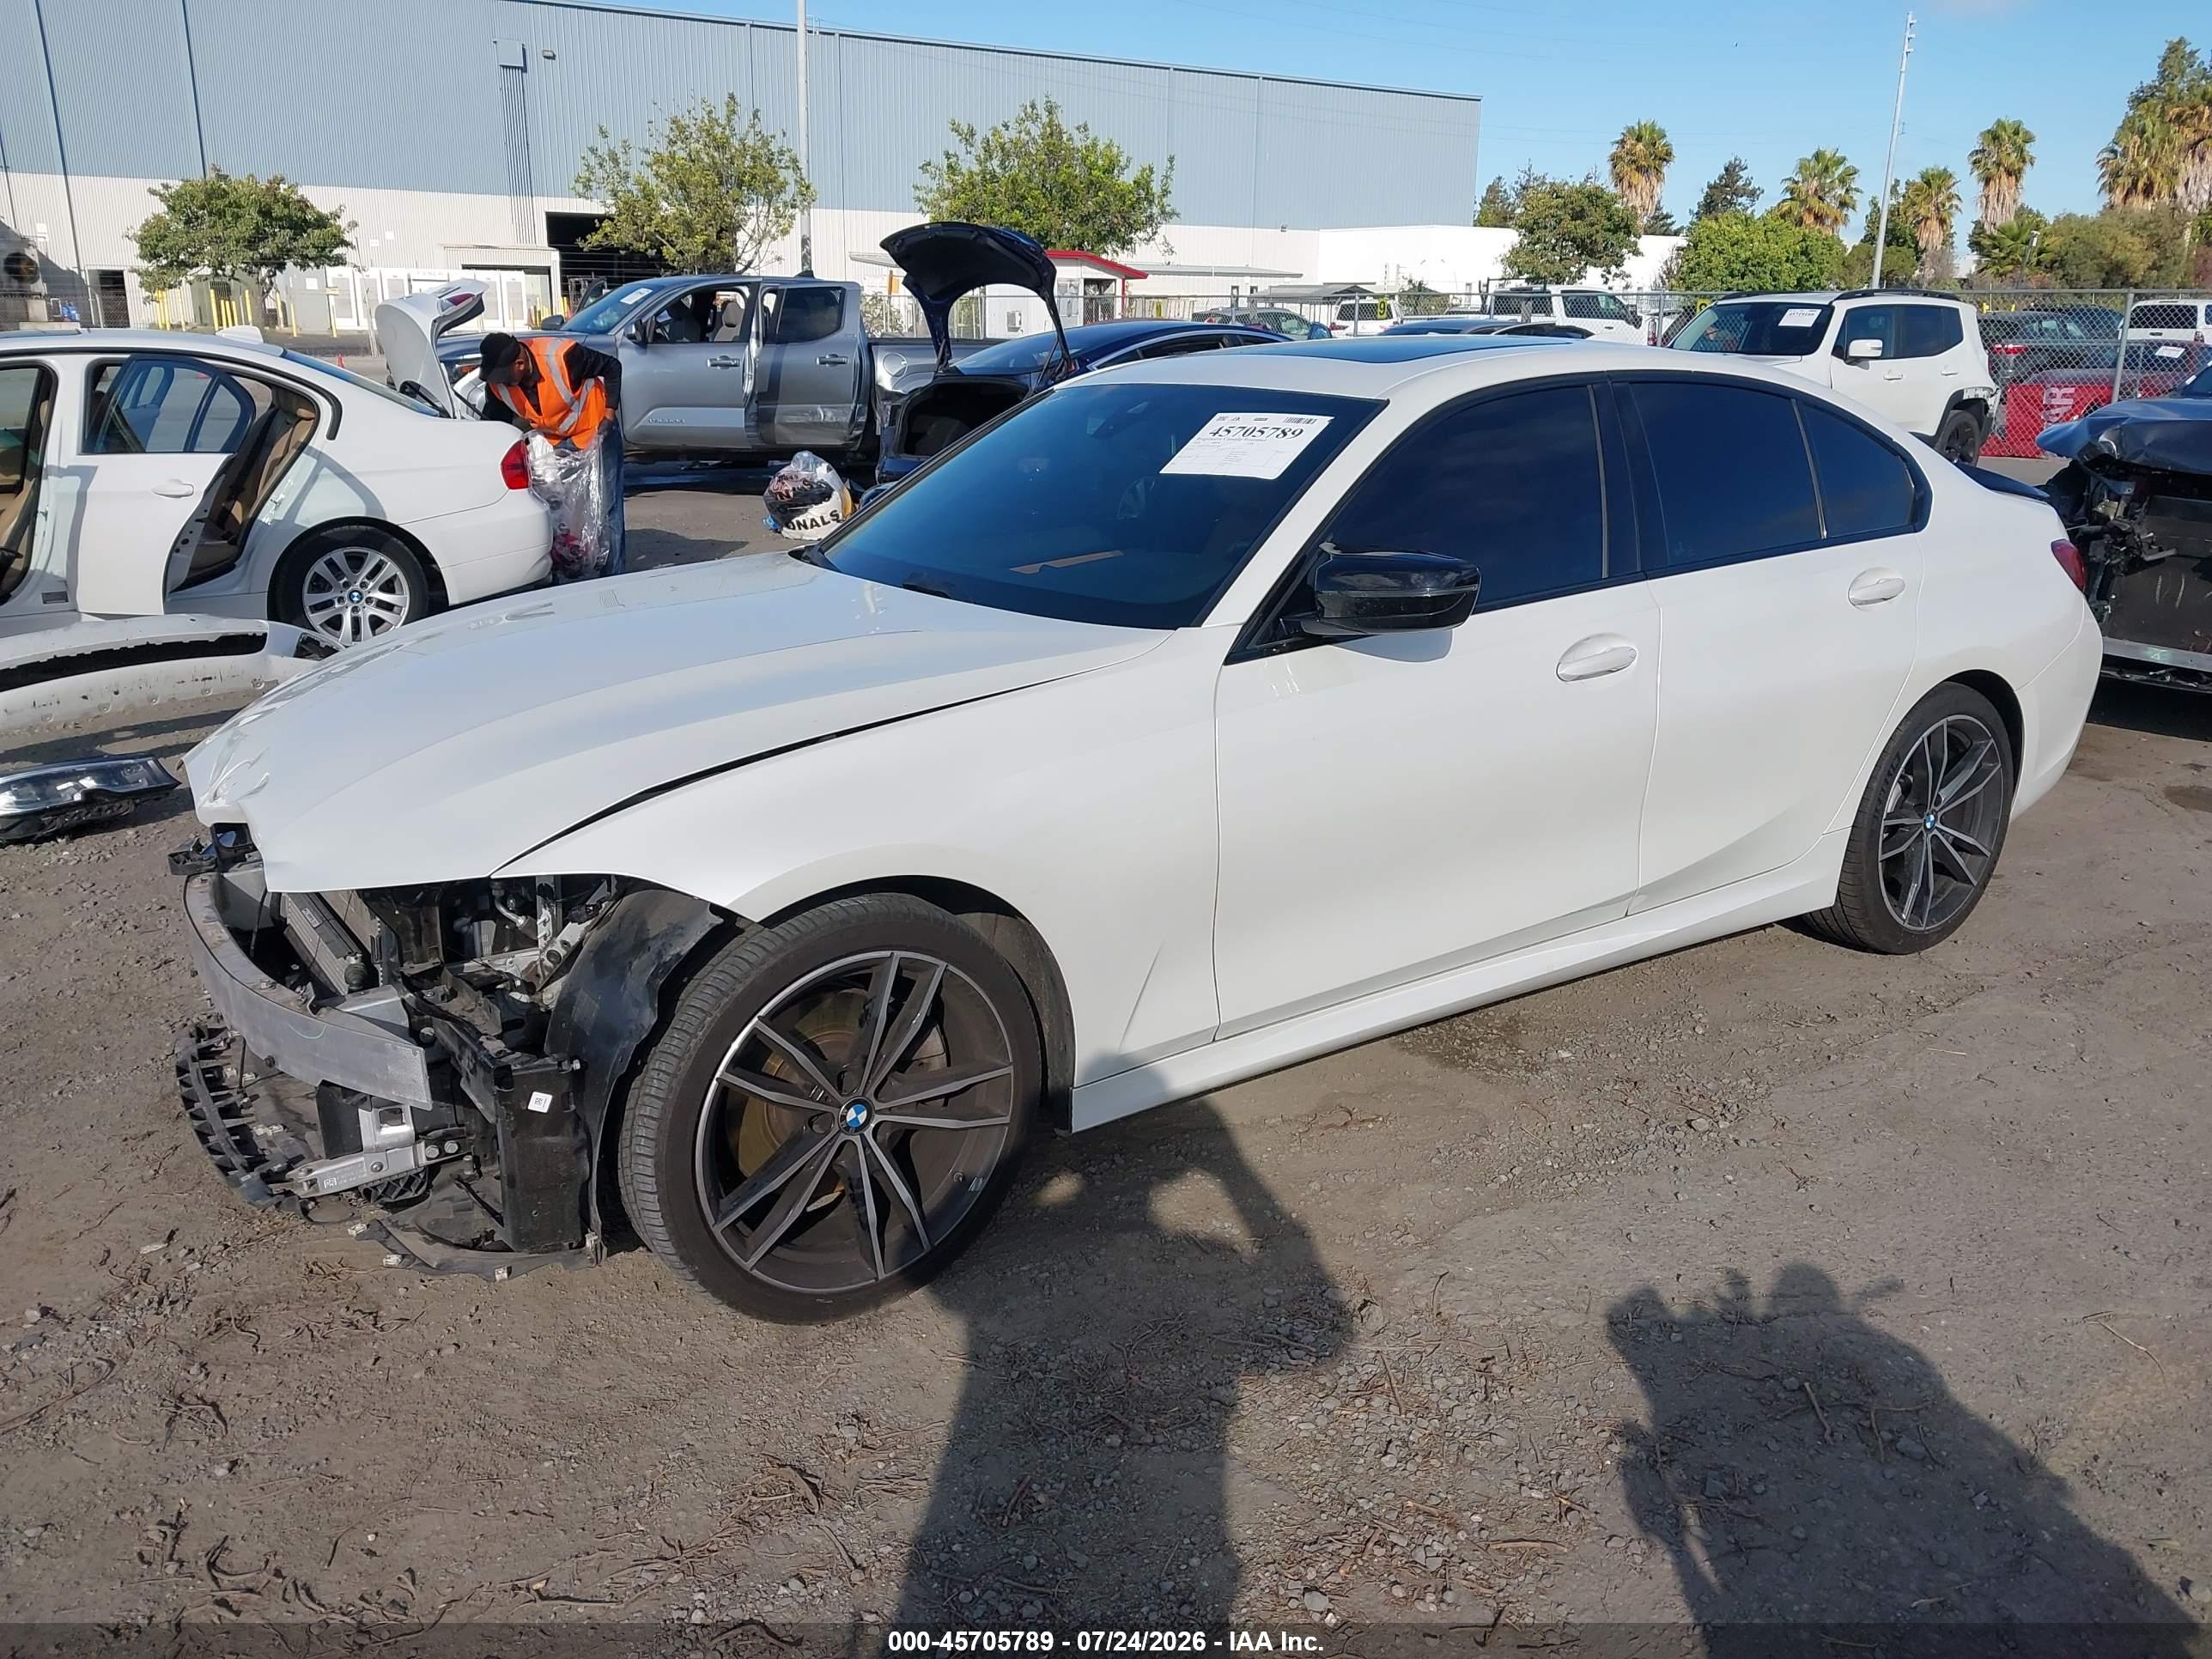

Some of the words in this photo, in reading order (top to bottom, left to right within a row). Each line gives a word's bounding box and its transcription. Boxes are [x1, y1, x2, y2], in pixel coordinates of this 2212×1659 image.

[1378, 301, 1386, 315] 9
[2041, 387, 2075, 427] AR
[1208, 425, 1304, 440] 45705789
